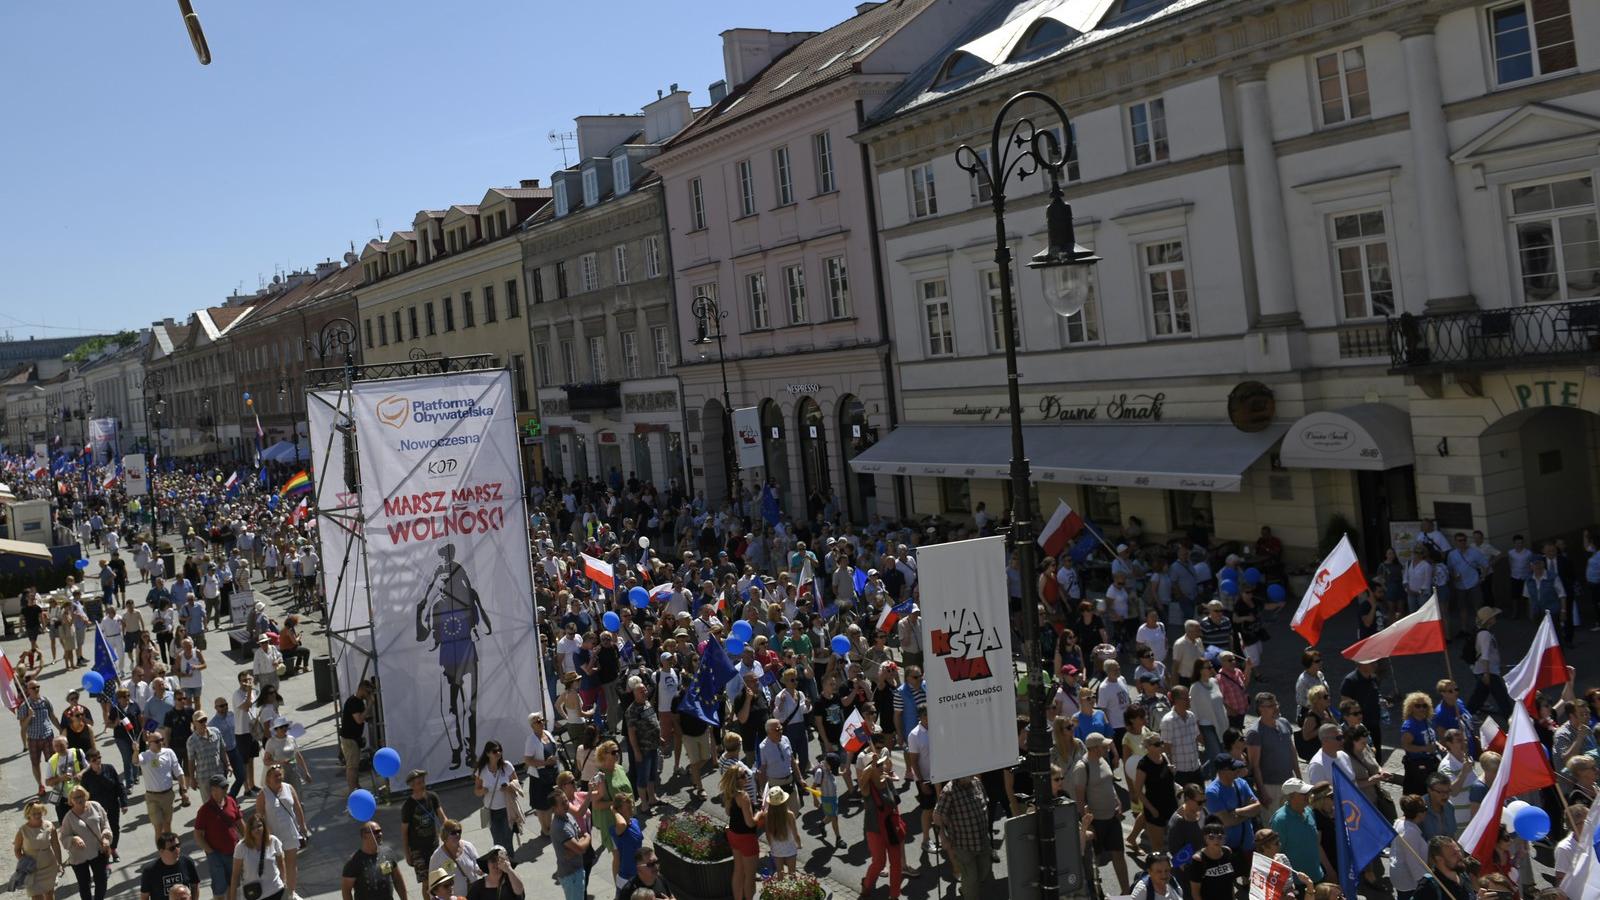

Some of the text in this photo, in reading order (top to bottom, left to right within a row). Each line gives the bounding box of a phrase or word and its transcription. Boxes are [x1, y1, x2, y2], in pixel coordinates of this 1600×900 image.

[1515, 381, 1578, 408] PTE
[412, 398, 475, 412] Platforma
[1039, 395, 1099, 420] Dawne
[413, 406, 494, 424] Obywatelska
[427, 459, 457, 474] KOD
[384, 491, 447, 517] MARSZ
[452, 483, 503, 503] MARSZ
[938, 684, 1003, 704] STOLICA WOLNOŚCI
[165, 876, 180, 884] NYC
